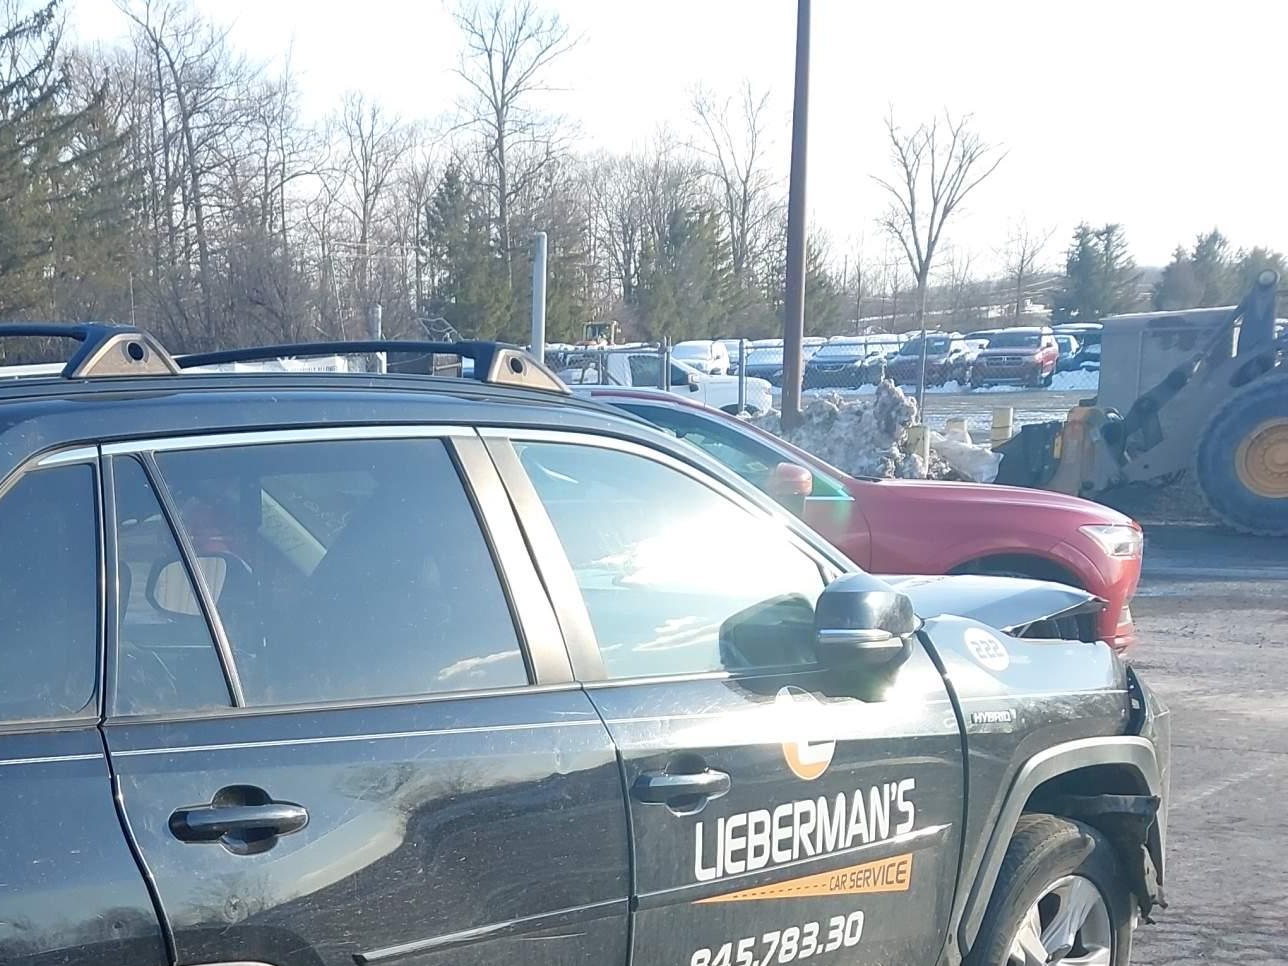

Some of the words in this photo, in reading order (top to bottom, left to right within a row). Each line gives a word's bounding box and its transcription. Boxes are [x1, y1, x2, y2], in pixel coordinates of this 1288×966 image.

[969, 639, 1005, 659] 222
[972, 711, 1012, 723] HYBRID
[694, 778, 915, 881] LIEBERMAN'S
[829, 873, 848, 892] CAR
[849, 861, 908, 889] SERVICE
